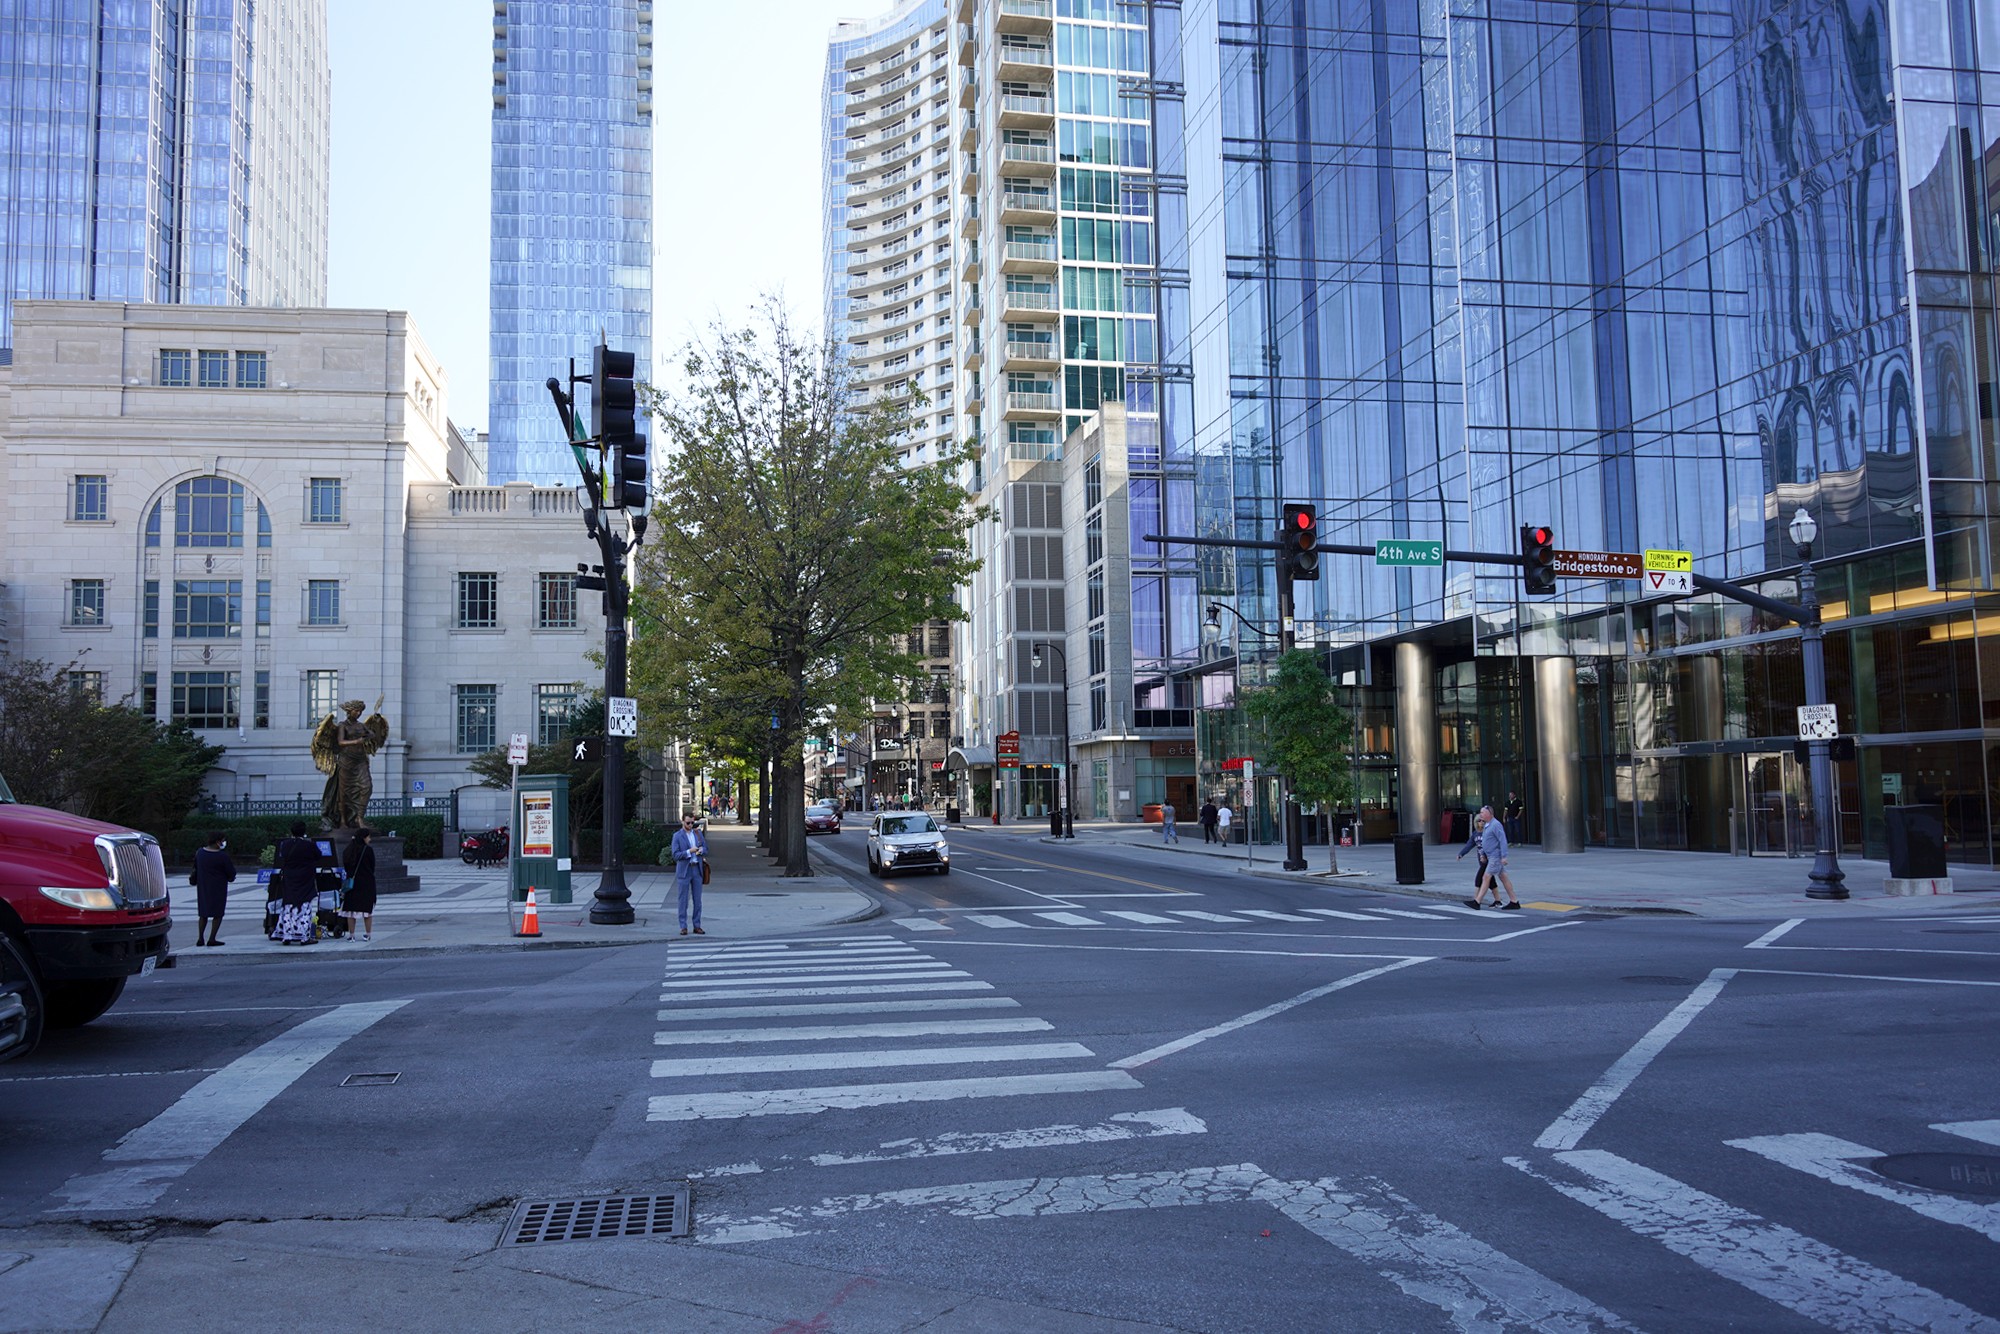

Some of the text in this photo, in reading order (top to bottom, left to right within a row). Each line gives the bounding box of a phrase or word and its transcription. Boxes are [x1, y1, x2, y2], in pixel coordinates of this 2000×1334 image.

[1379, 546, 1440, 560] 4th Ave S
[1578, 552, 1608, 562] HONORARY
[1650, 553, 1674, 562] TURNING
[1553, 560, 1638, 575] Bridgestone Dr
[1647, 560, 1676, 569] VEHICLES
[1668, 578, 1676, 586] TO
[613, 699, 634, 707] DIAGONAL
[613, 706, 634, 715] CROSSING
[1803, 706, 1832, 714] DIAGONAL
[1803, 712, 1832, 721] CROSSING
[610, 716, 621, 730] OK
[1801, 722, 1816, 736] OK
